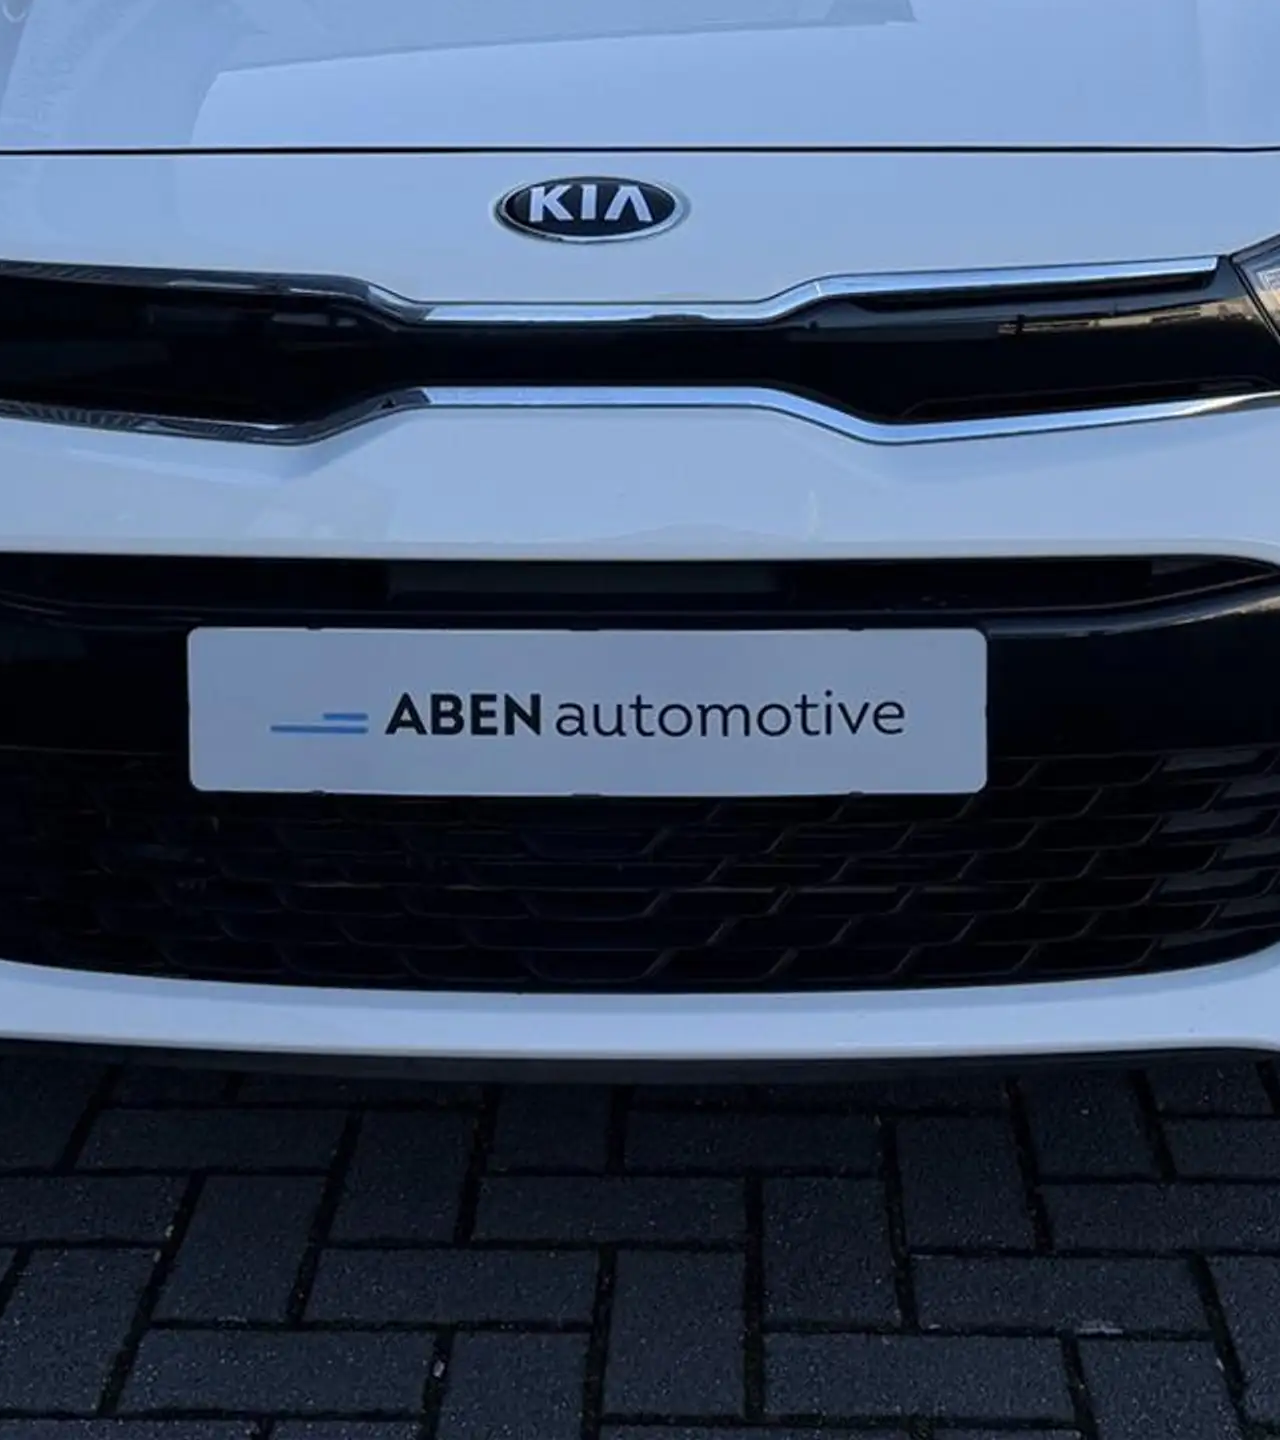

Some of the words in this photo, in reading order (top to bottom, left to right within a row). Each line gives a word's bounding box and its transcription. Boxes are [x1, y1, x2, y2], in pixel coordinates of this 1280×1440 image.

[528, 183, 653, 222] KIA
[384, 692, 542, 736] ABEN
[555, 690, 906, 737] automotive
